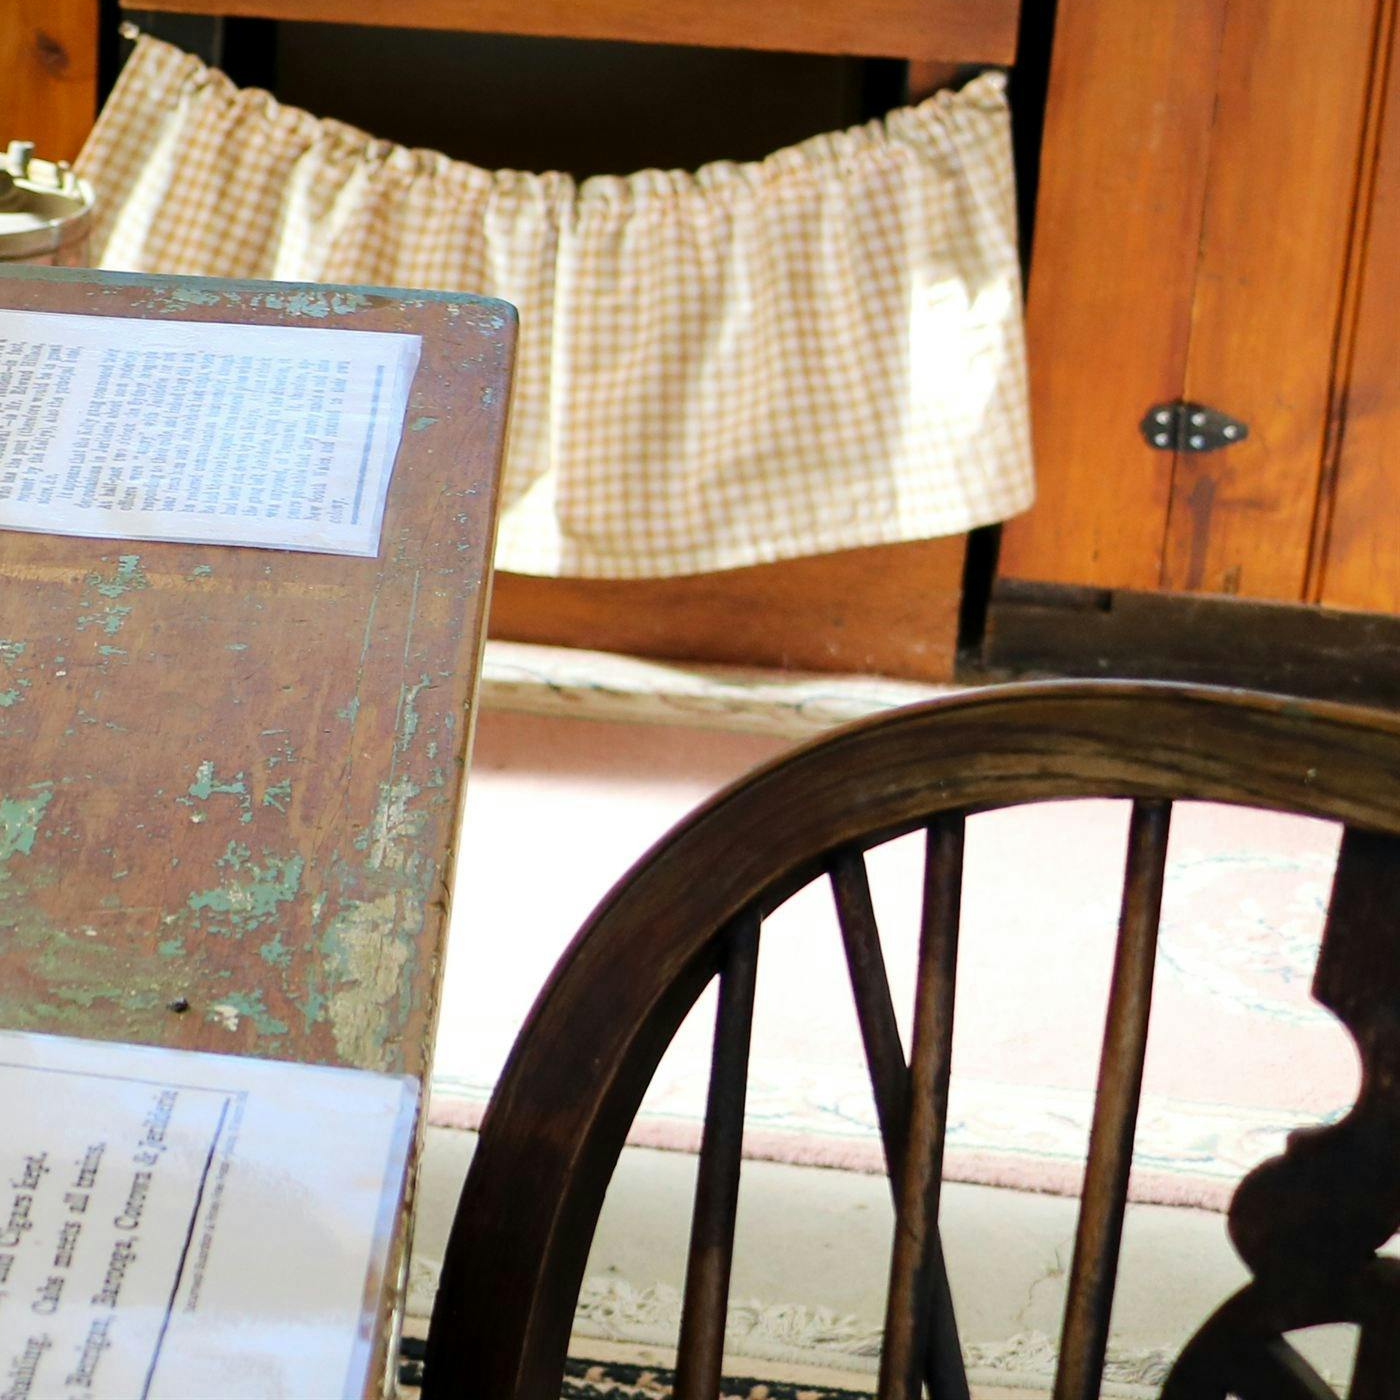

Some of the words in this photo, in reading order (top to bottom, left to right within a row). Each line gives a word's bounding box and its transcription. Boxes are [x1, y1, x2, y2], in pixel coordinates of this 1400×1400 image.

[11, 1151, 50, 1190] kept.
[72, 1141, 107, 1189] trains.
[133, 1151, 159, 1166] &
[63, 1192, 89, 1214] all
[113, 1171, 152, 1231] Corowa
[53, 1220, 81, 1268] meets
[90, 1235, 141, 1308] Barooga,
[31, 1275, 65, 1315] Cabs
